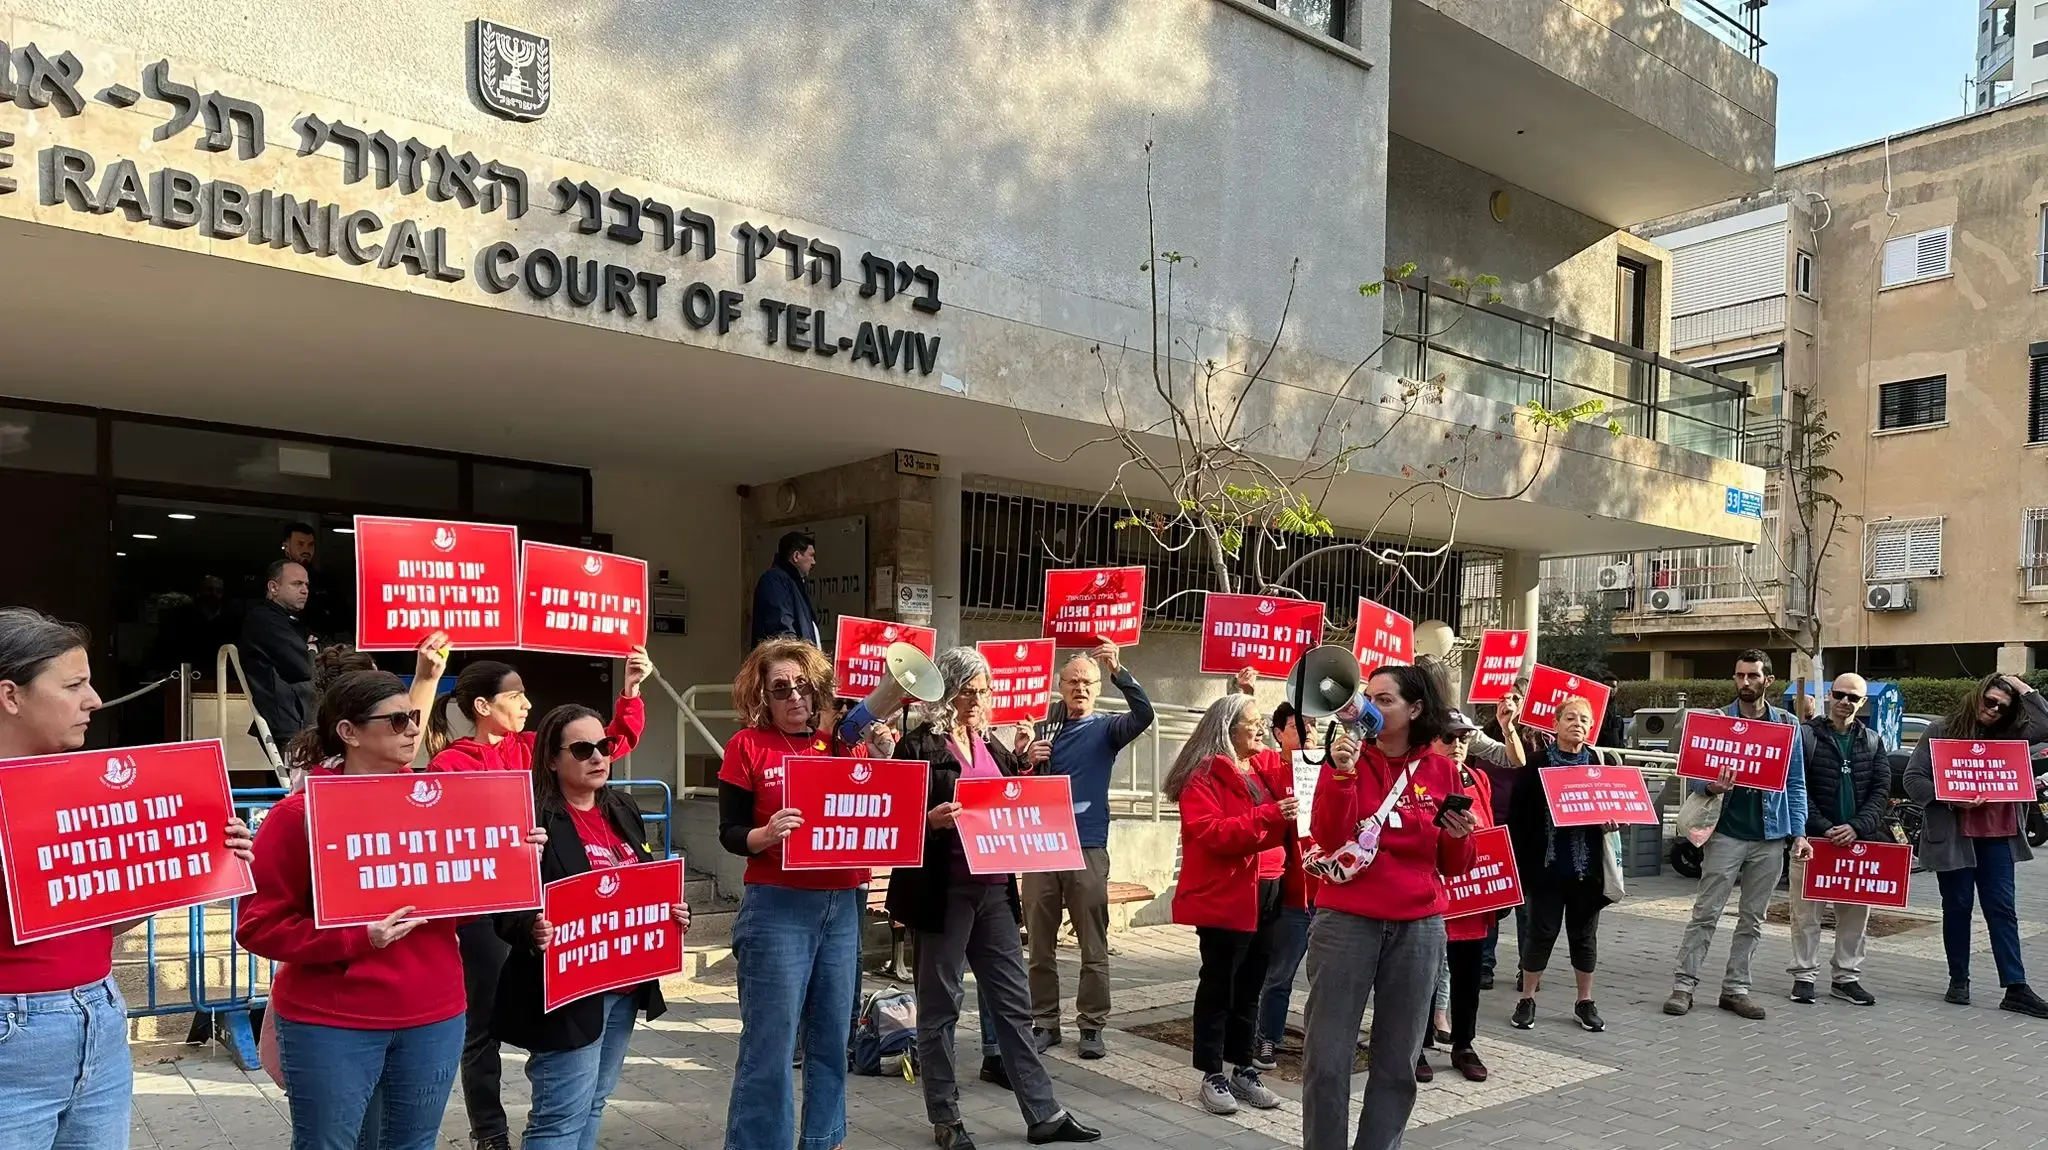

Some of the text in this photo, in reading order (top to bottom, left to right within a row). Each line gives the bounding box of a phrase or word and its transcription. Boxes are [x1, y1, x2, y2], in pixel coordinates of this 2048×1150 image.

[497, 88, 537, 110] ישראל
[294, 112, 529, 220] האזורי
[550, 177, 716, 261] הרבני
[40, 145, 464, 283] RABBINICAL
[478, 241, 666, 320] COURT
[683, 282, 743, 335] OF
[760, 298, 941, 375] TEL-AVIV
[735, 222, 841, 289] הדין
[859, 252, 942, 314] בית
[904, 454, 914, 469] 33
[1728, 492, 1738, 508] 33
[398, 560, 484, 580] יותר סמכויות
[382, 584, 499, 605] לבתי הדין הדתיים
[542, 587, 569, 606] חזק
[574, 590, 598, 611] דתי
[602, 593, 619, 612] דין
[622, 597, 642, 615] בית
[387, 608, 500, 630] זה מדרון חלקלק
[546, 610, 629, 635] אישה חלשה
[1214, 620, 1312, 644] זה לא בהסכמה
[860, 644, 888, 658] מכויות
[1231, 642, 1292, 663] זו כפייה!
[1691, 736, 1781, 760] זה לא בהסכמה
[1749, 761, 1762, 774] זו
[56, 794, 183, 834] יותר סמכויות
[824, 792, 892, 818] למעשה
[989, 806, 1042, 830] אין דין
[37, 820, 208, 871] לבתי הדין הדתיים
[346, 832, 391, 860] חזק
[399, 830, 436, 853] דתי
[446, 827, 476, 854] דין
[485, 825, 521, 849] בית
[812, 825, 899, 850] זאת הלכה
[976, 832, 1068, 855] כשאין דיינת
[359, 858, 496, 889] אישה חלשה
[1835, 859, 1880, 875] אין דין
[48, 852, 212, 907] זה מדרון חלקלק
[1815, 874, 1897, 894] כשאין דיינת
[554, 902, 670, 947] השנה היא 2024
[558, 928, 664, 974] לא ימי הביניים
